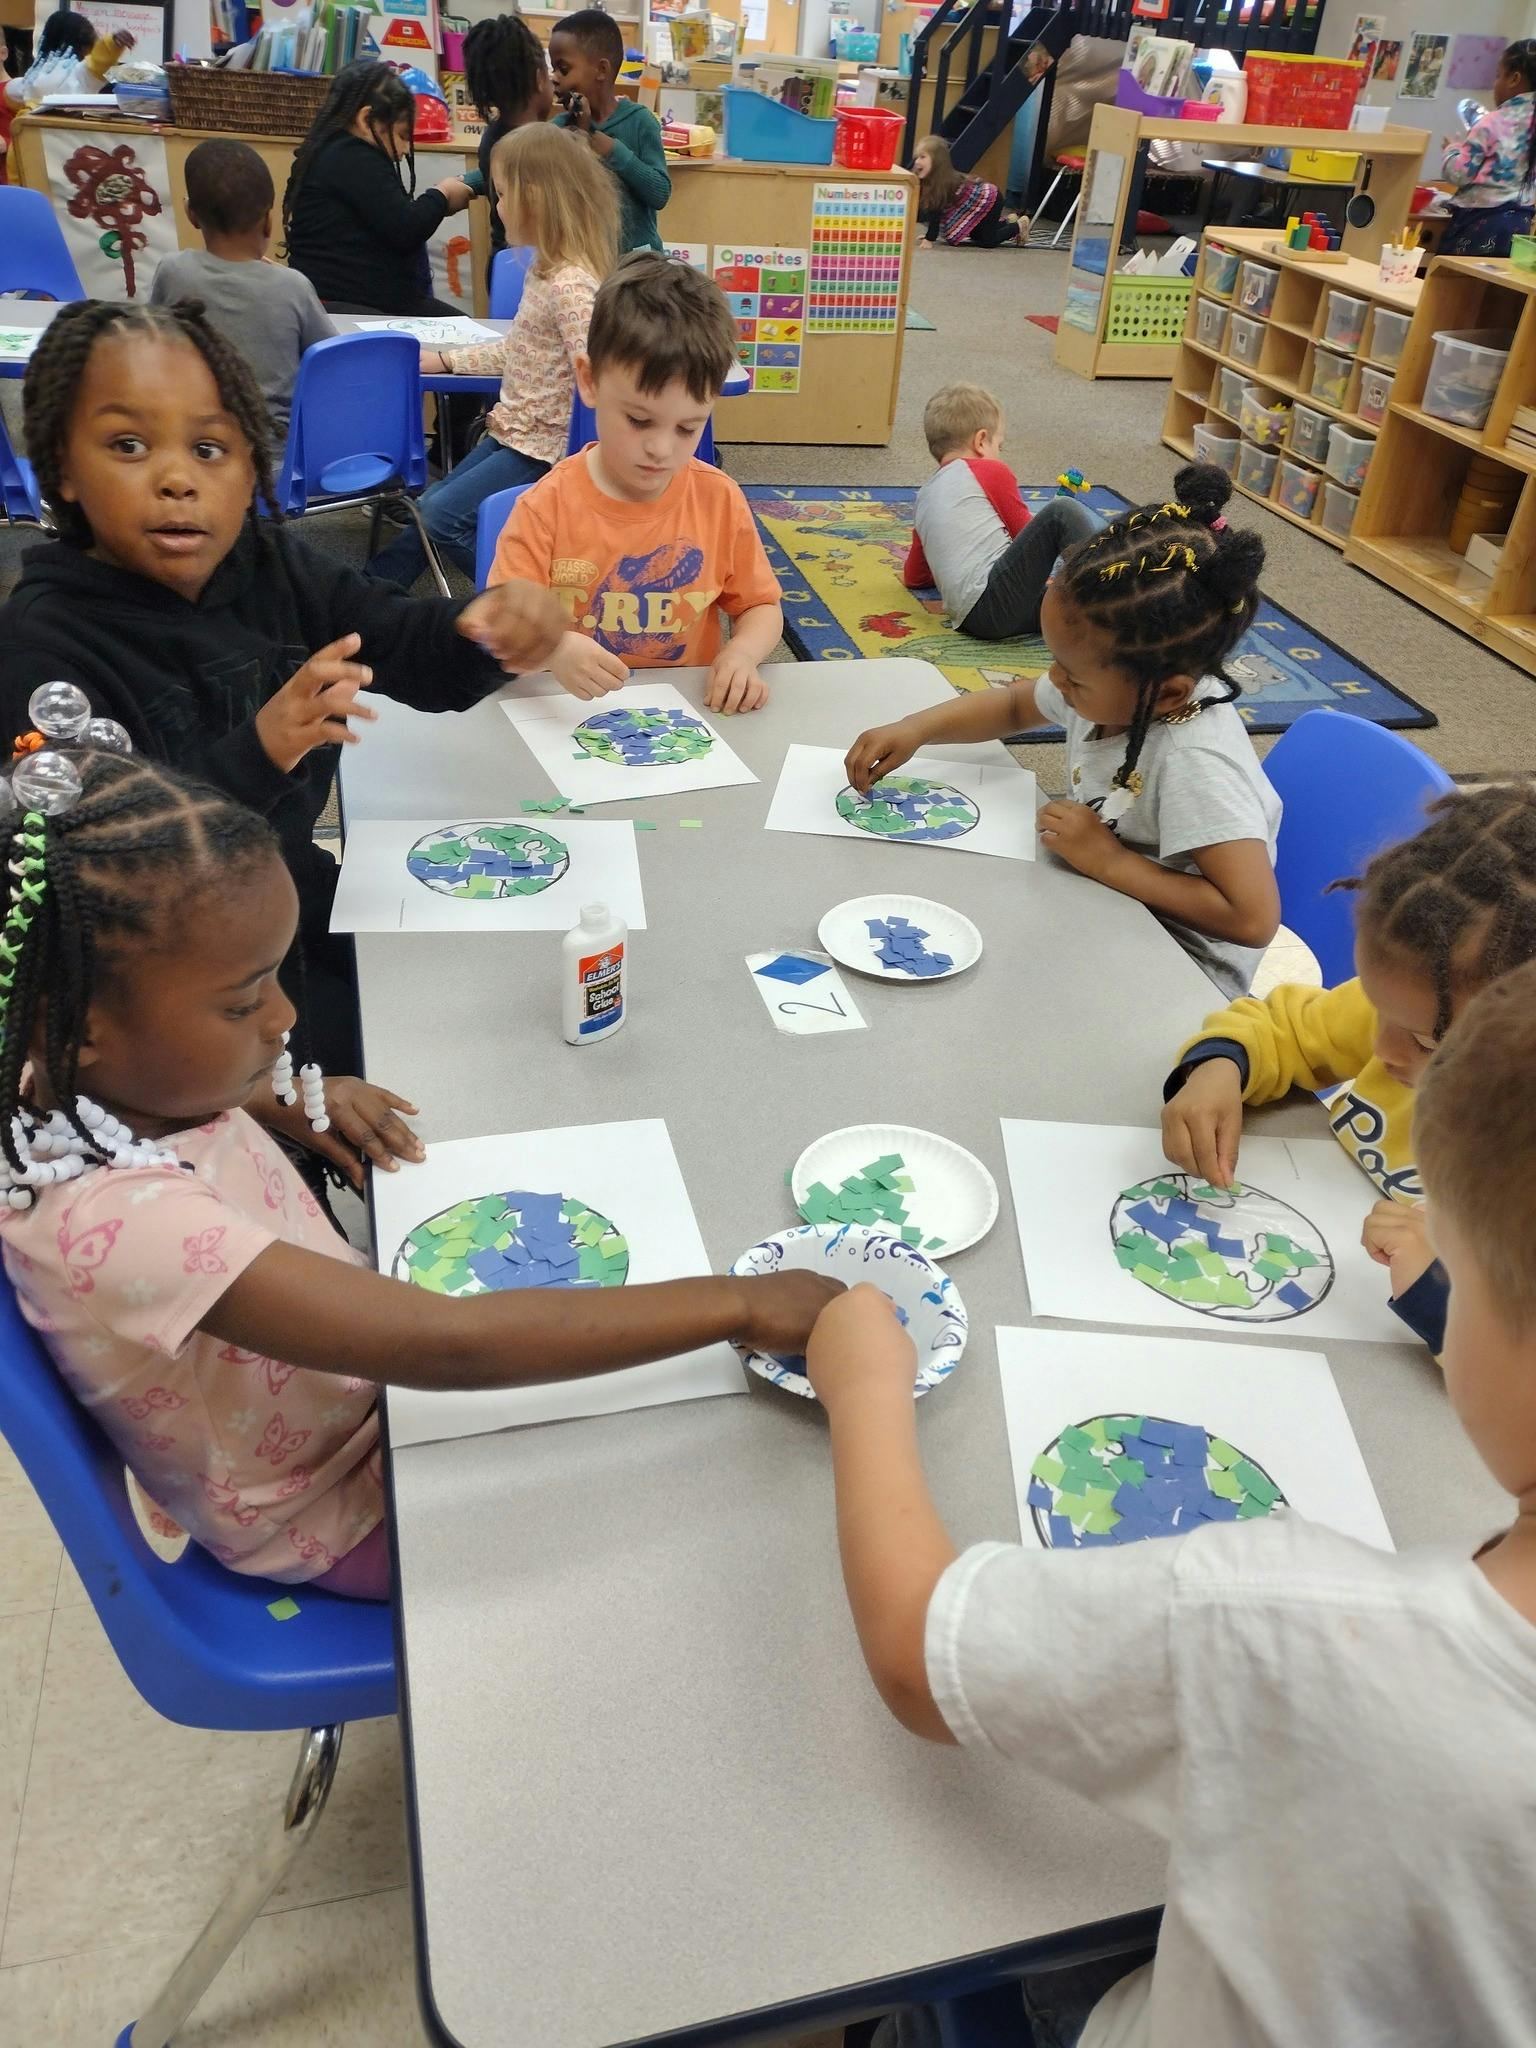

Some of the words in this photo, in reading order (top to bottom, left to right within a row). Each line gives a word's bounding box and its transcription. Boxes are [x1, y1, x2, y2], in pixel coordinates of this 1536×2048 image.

[817, 187, 870, 200] Numbers
[874, 189, 903, 200] 1-100
[720, 249, 802, 266] Opposites
[553, 560, 596, 574] URASSIC
[586, 960, 622, 982] ELMER'S
[589, 981, 620, 1003] School
[593, 997, 614, 1011] Glue
[1332, 1092, 1424, 1200] Pol
